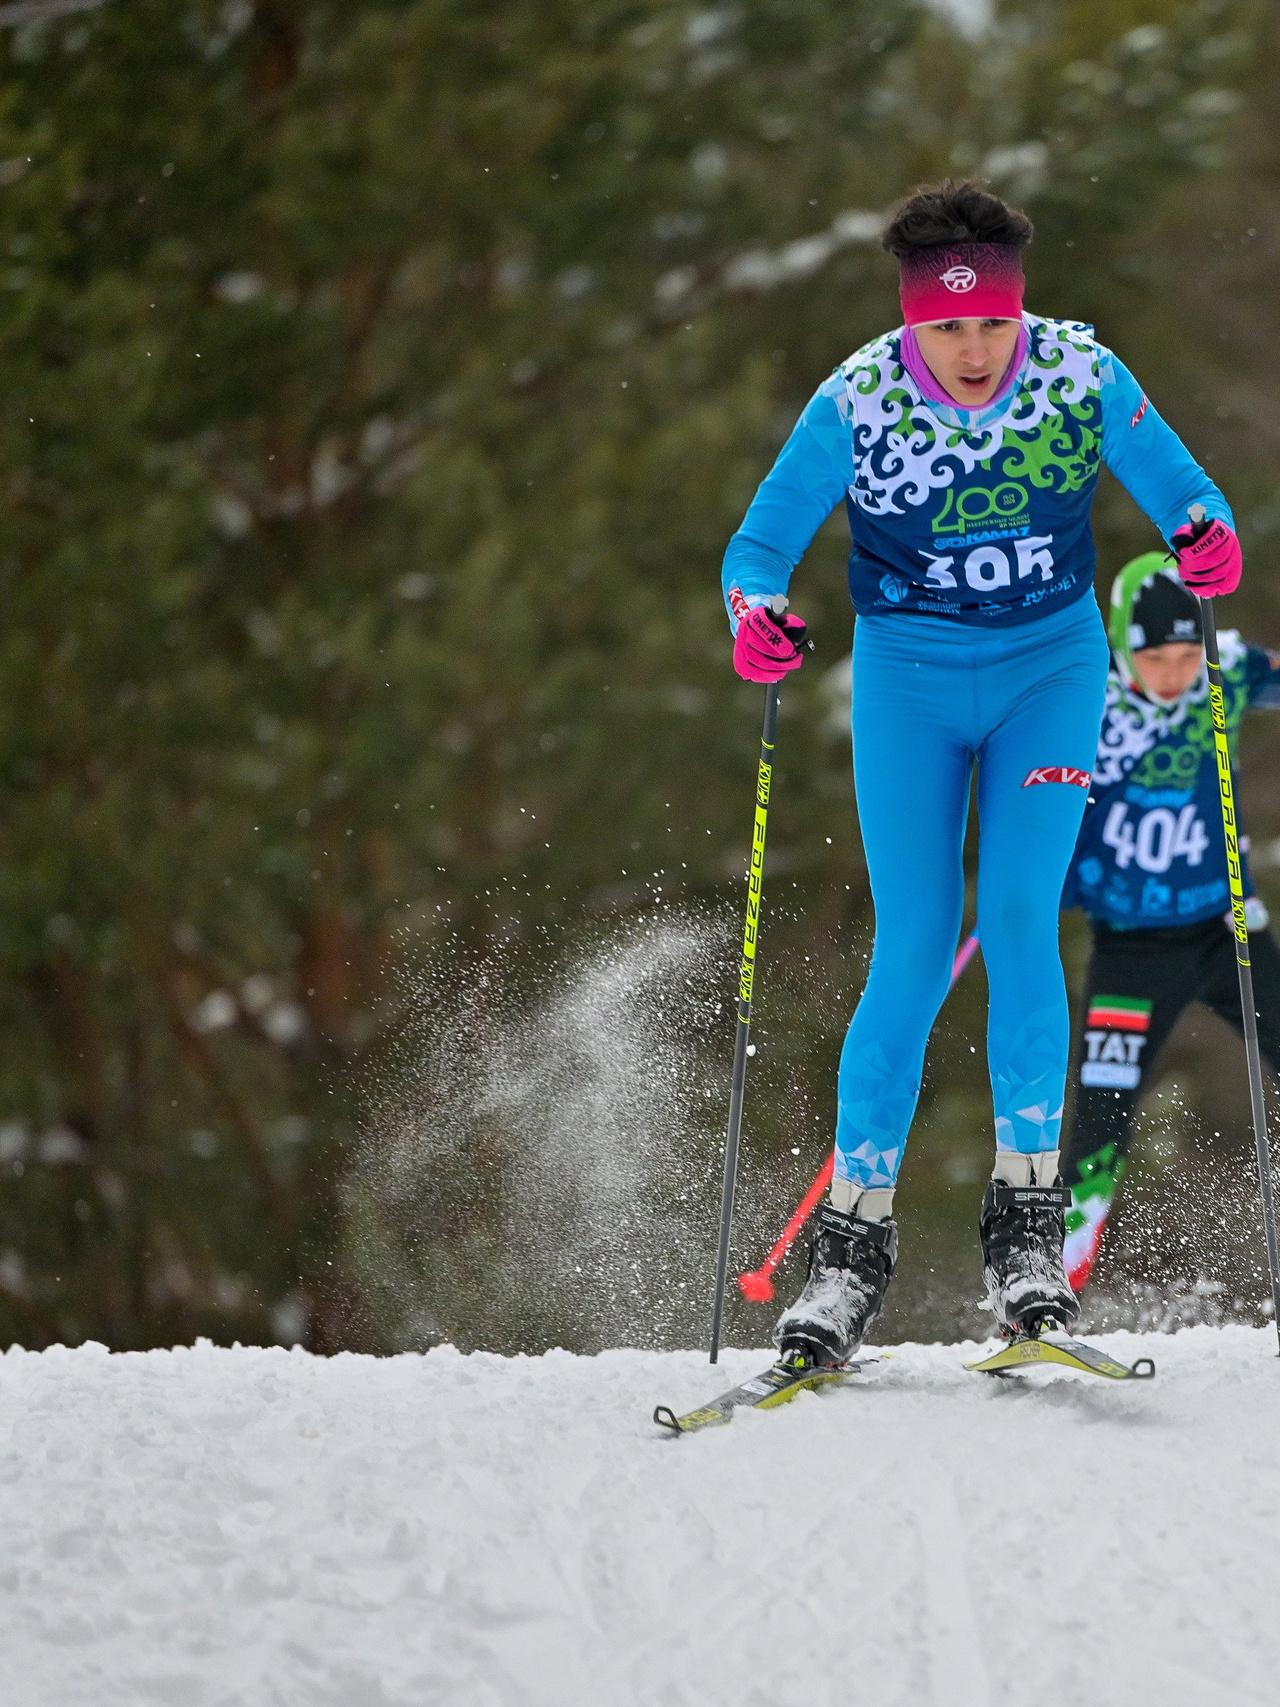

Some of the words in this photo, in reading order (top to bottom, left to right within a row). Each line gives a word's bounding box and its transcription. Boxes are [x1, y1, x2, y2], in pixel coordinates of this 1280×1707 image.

[966, 526, 1031, 545] KAMAZ
[1023, 767, 1090, 788] KV+
[1102, 801, 1210, 874] 404
[1084, 1031, 1147, 1063] TAT
[1014, 1192, 1063, 1203] SPINE
[821, 1211, 869, 1235] SPINE
